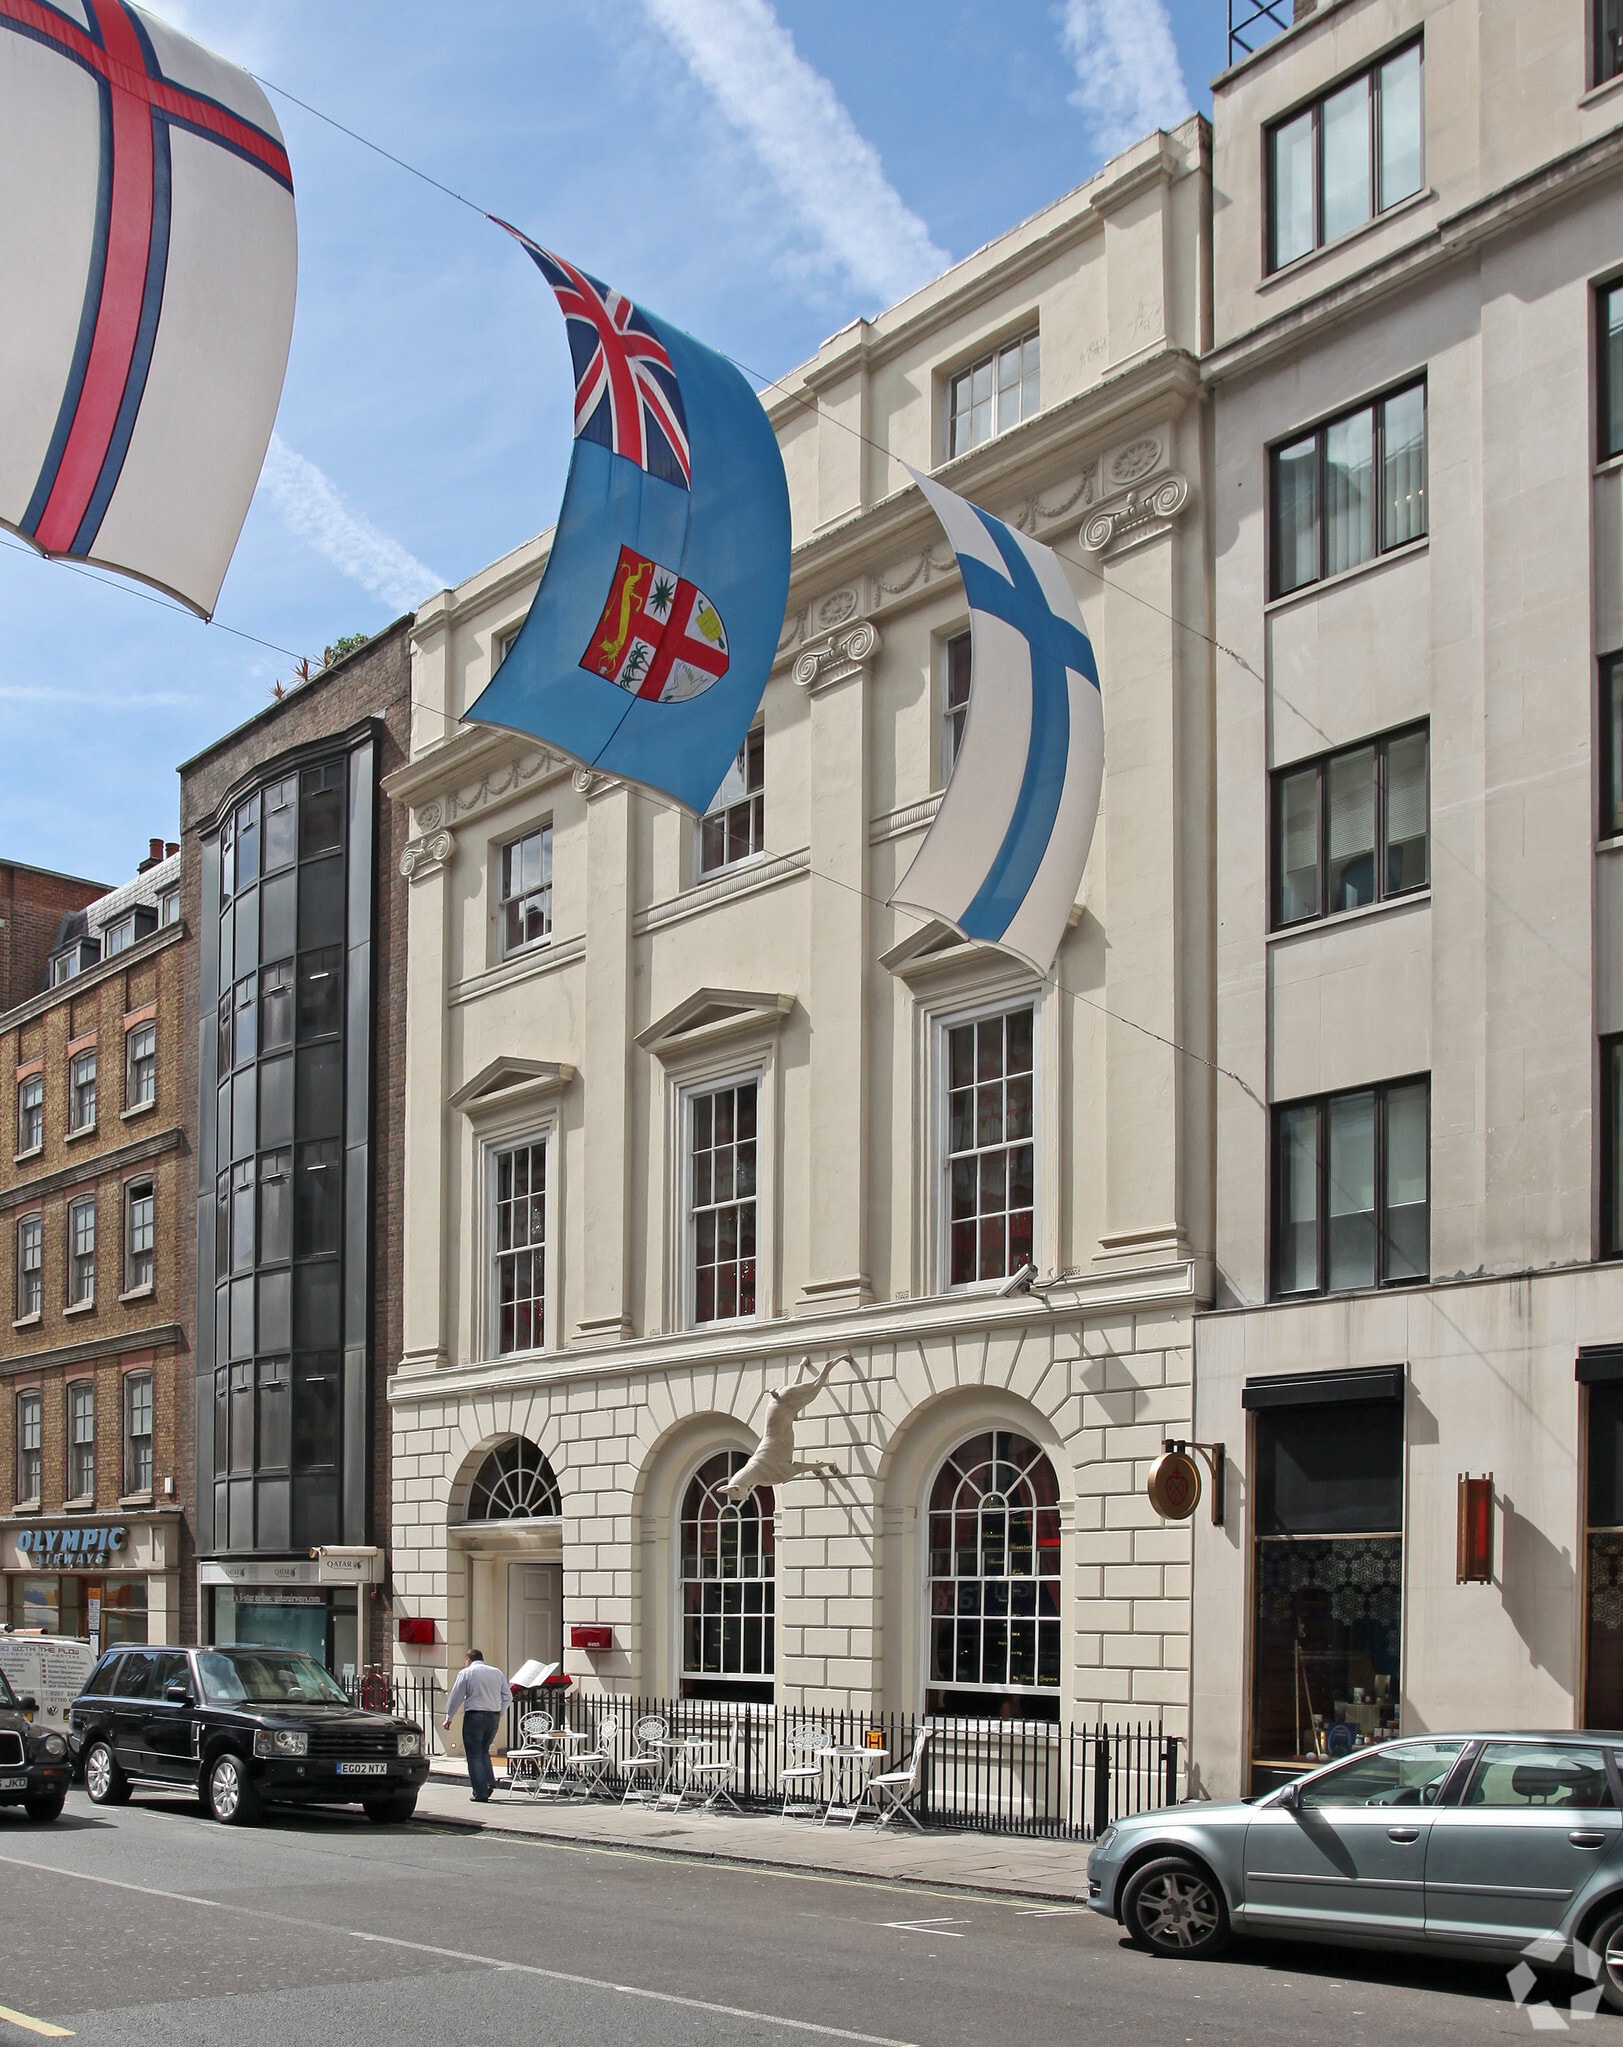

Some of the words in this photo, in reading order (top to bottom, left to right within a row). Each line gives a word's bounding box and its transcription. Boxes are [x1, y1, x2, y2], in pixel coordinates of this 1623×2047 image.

[17, 1527, 125, 1552] OLYMPIC
[36, 1553, 104, 1564] AIRWAYS
[275, 1569, 290, 1577] QATAR
[342, 1764, 367, 1773] EG02
[368, 1764, 385, 1773] NTX
